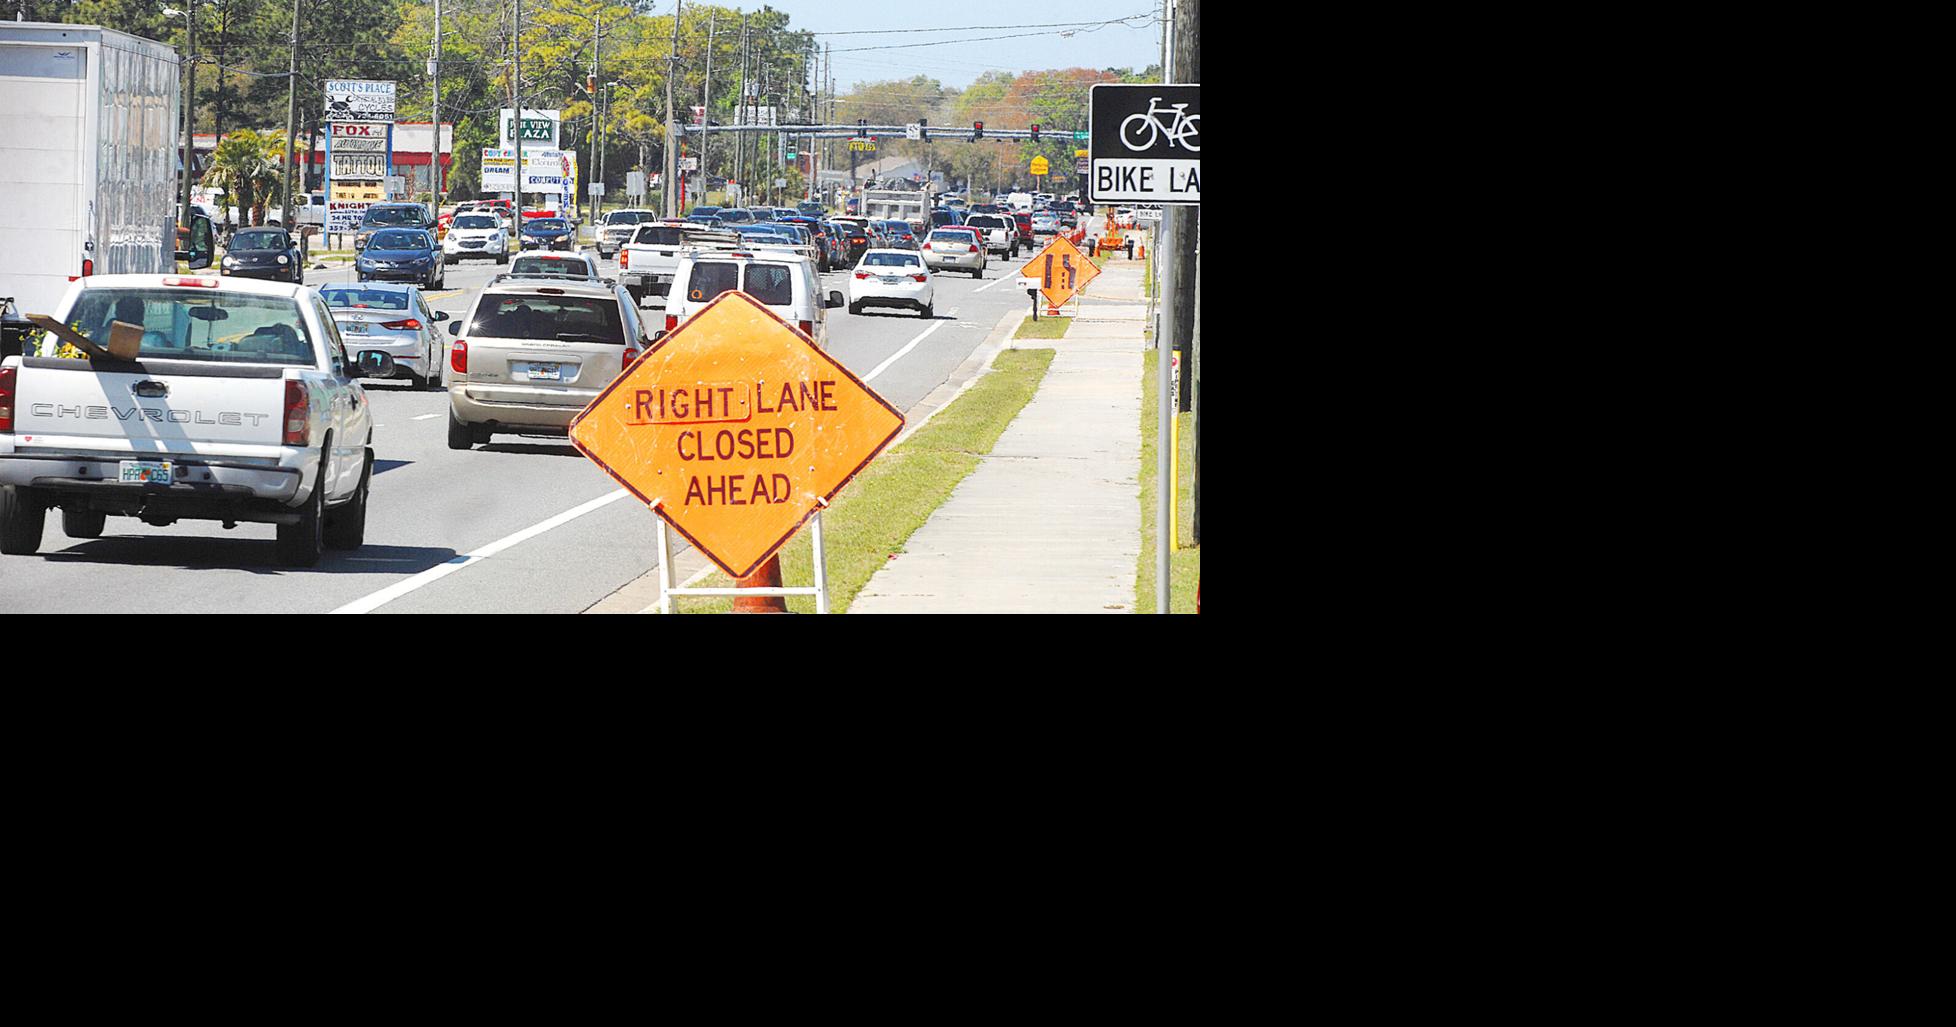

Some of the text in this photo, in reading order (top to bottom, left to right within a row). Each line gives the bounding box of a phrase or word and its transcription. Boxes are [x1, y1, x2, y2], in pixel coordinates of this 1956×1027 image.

[365, 83, 391, 93] PLACE
[333, 126, 370, 136] FOX
[333, 155, 384, 176] TATTOO
[1098, 166, 1154, 192] BIKE
[1170, 167, 1200, 192] LA
[635, 381, 837, 419] RIGHT LANE
[31, 403, 269, 427] CHEVROLET
[677, 428, 794, 461] CLOSED
[684, 474, 791, 505] AHEAD
